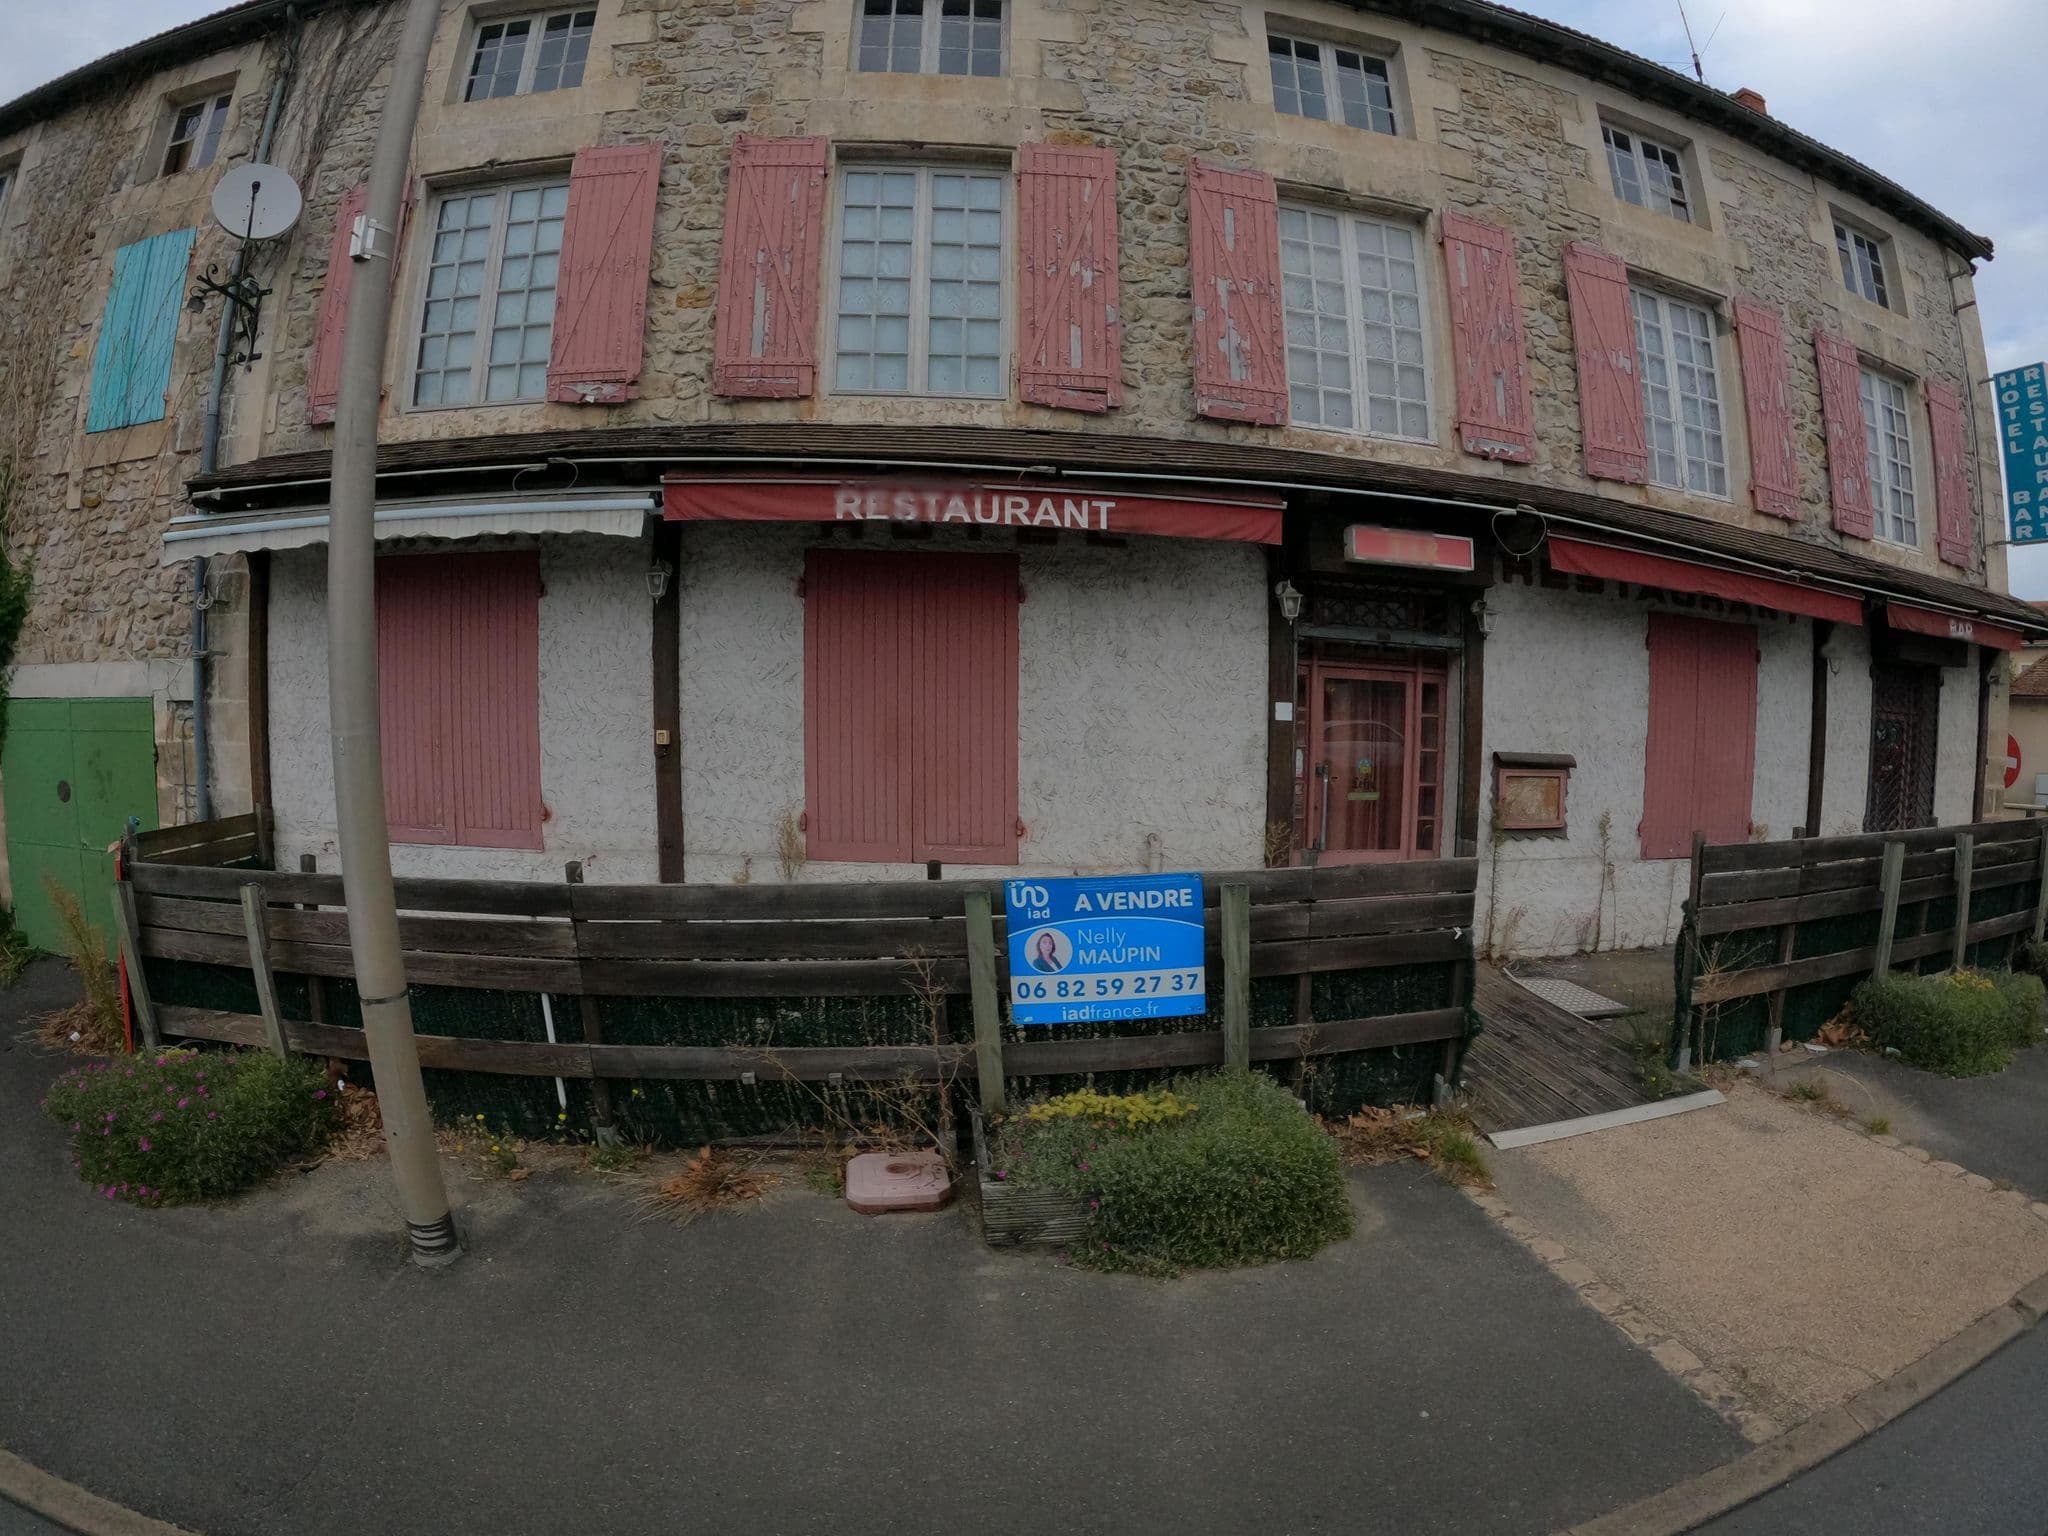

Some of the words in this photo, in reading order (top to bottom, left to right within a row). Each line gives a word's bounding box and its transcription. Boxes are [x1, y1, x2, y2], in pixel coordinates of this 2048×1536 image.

[1999, 375, 2024, 455] HOTEL
[834, 490, 1116, 530] RESTAURANT
[2012, 490, 2033, 539] BAR
[1074, 893, 1093, 912] A
[1096, 888, 1193, 911] VENDRE
[1027, 907, 1050, 919] iad
[1078, 927, 1126, 948] Nelly
[1079, 946, 1161, 965] MAUPIN
[1017, 981, 1047, 999] 06
[1056, 979, 1086, 997] 82
[1095, 978, 1125, 996] 59
[1134, 976, 1162, 994] 27
[1171, 973, 1199, 991] 37
[1062, 1001, 1160, 1021] iadfrance.fr
